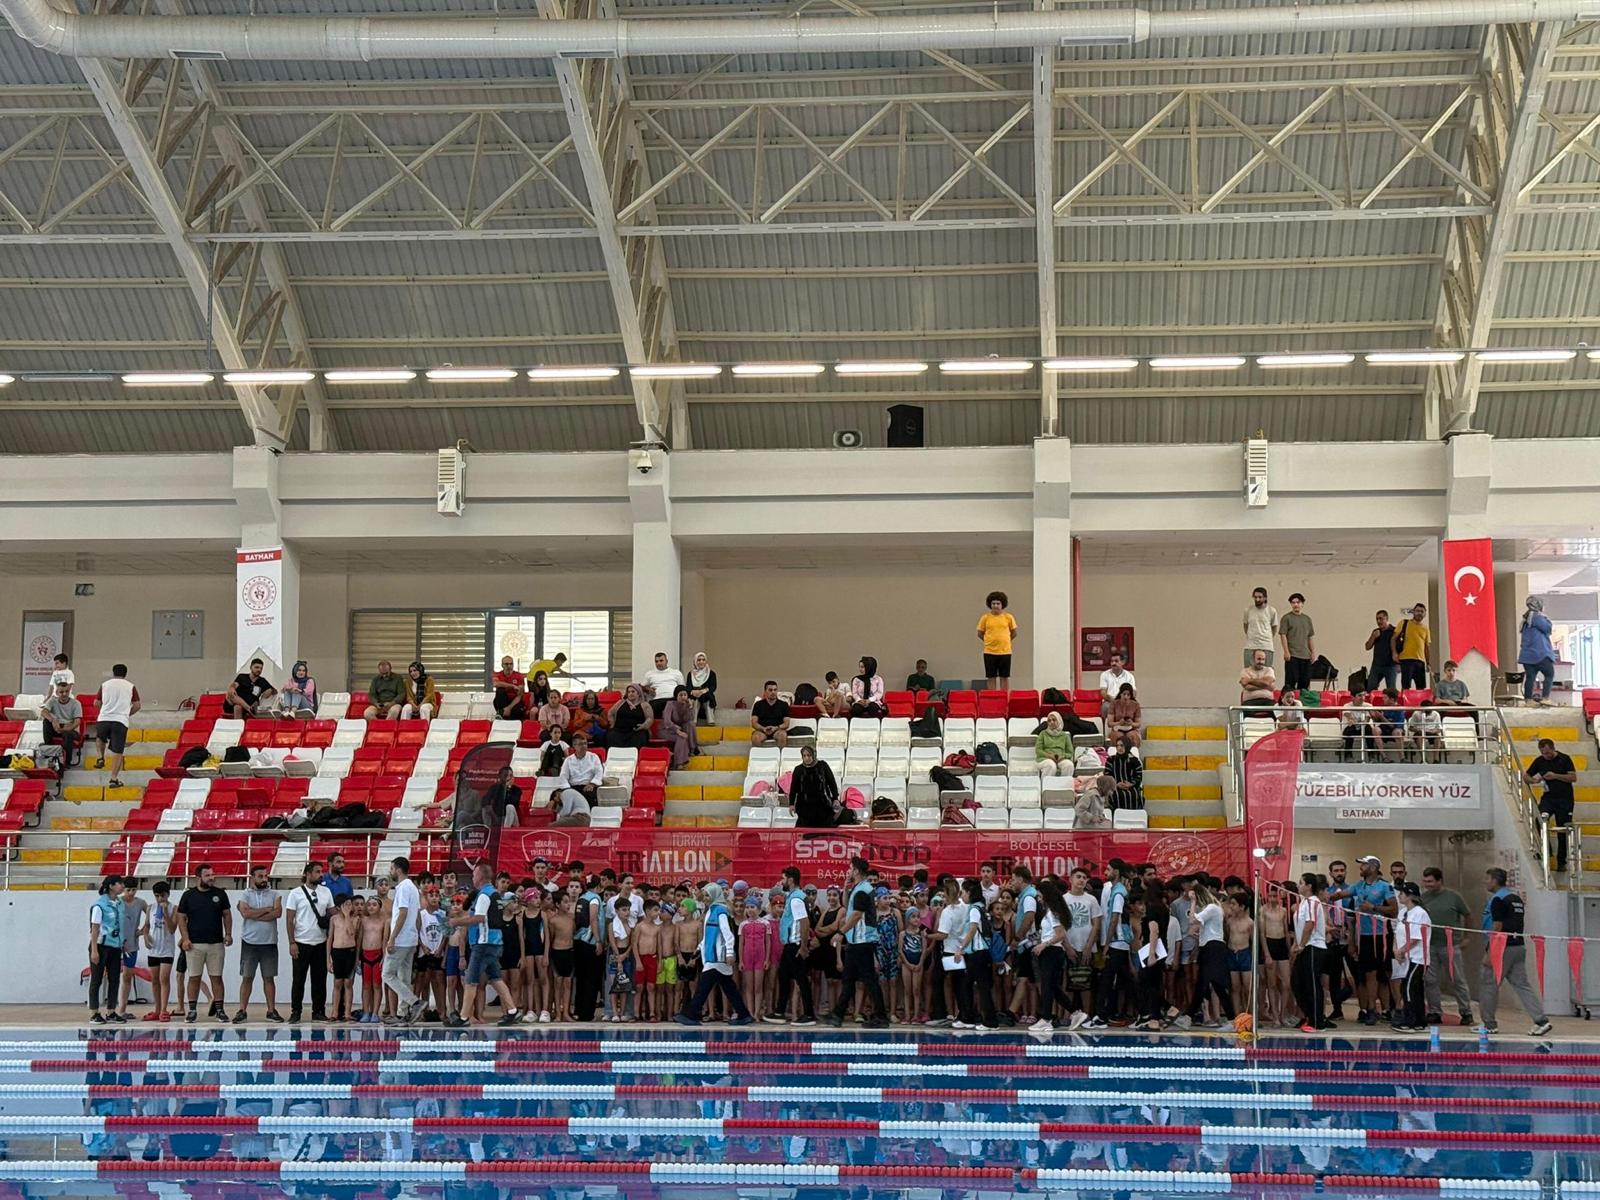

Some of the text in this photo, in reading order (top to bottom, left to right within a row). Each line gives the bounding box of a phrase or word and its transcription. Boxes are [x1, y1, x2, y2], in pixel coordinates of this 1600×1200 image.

[245, 553, 274, 561] BATMAN
[1295, 781, 1471, 799] YÜZEBİLİYORKEN YÜZ
[1342, 809, 1384, 818] BATMAN
[672, 833, 712, 847] TÜRKİYE
[1010, 839, 1081, 851] BÖLGESEL
